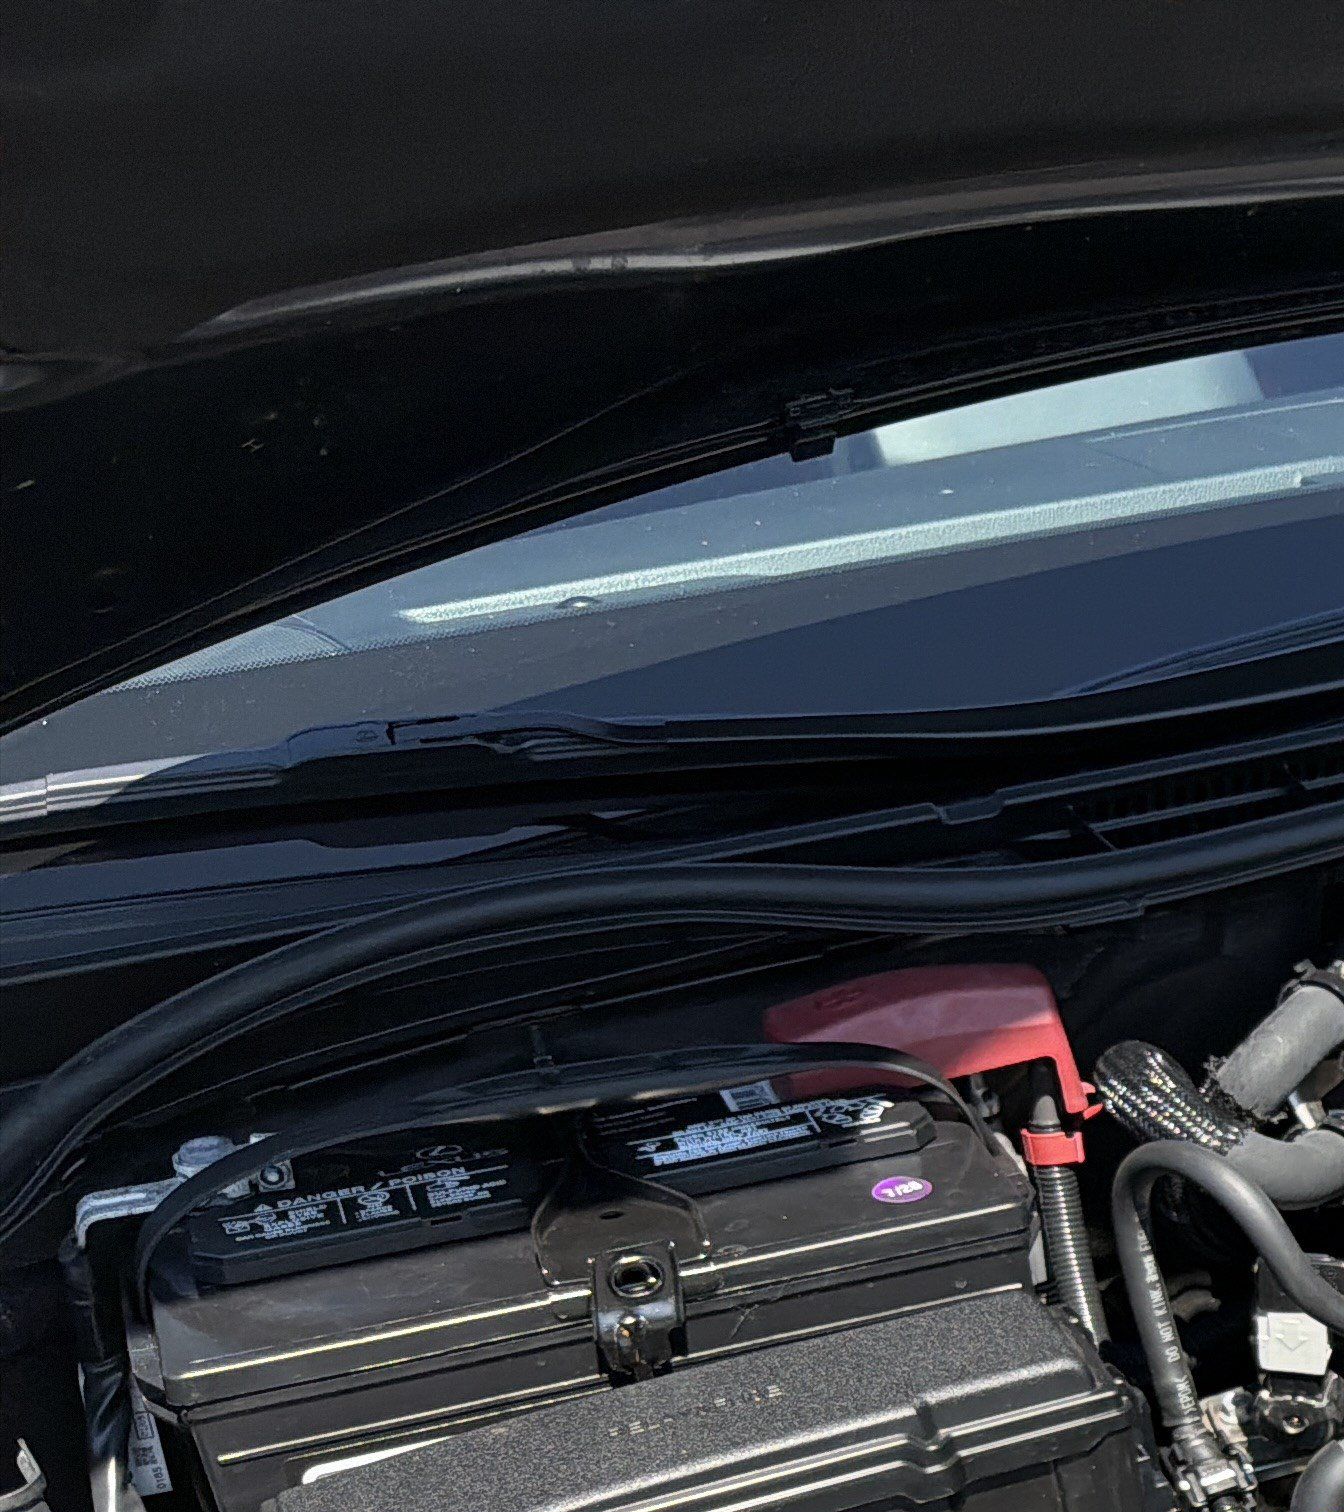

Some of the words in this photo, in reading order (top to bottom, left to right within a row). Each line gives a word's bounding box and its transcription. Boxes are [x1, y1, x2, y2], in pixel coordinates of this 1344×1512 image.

[276, 1185, 366, 1208] DANGER
[1157, 1320, 1175, 1343] NOT
[1164, 1345, 1181, 1363] DO
